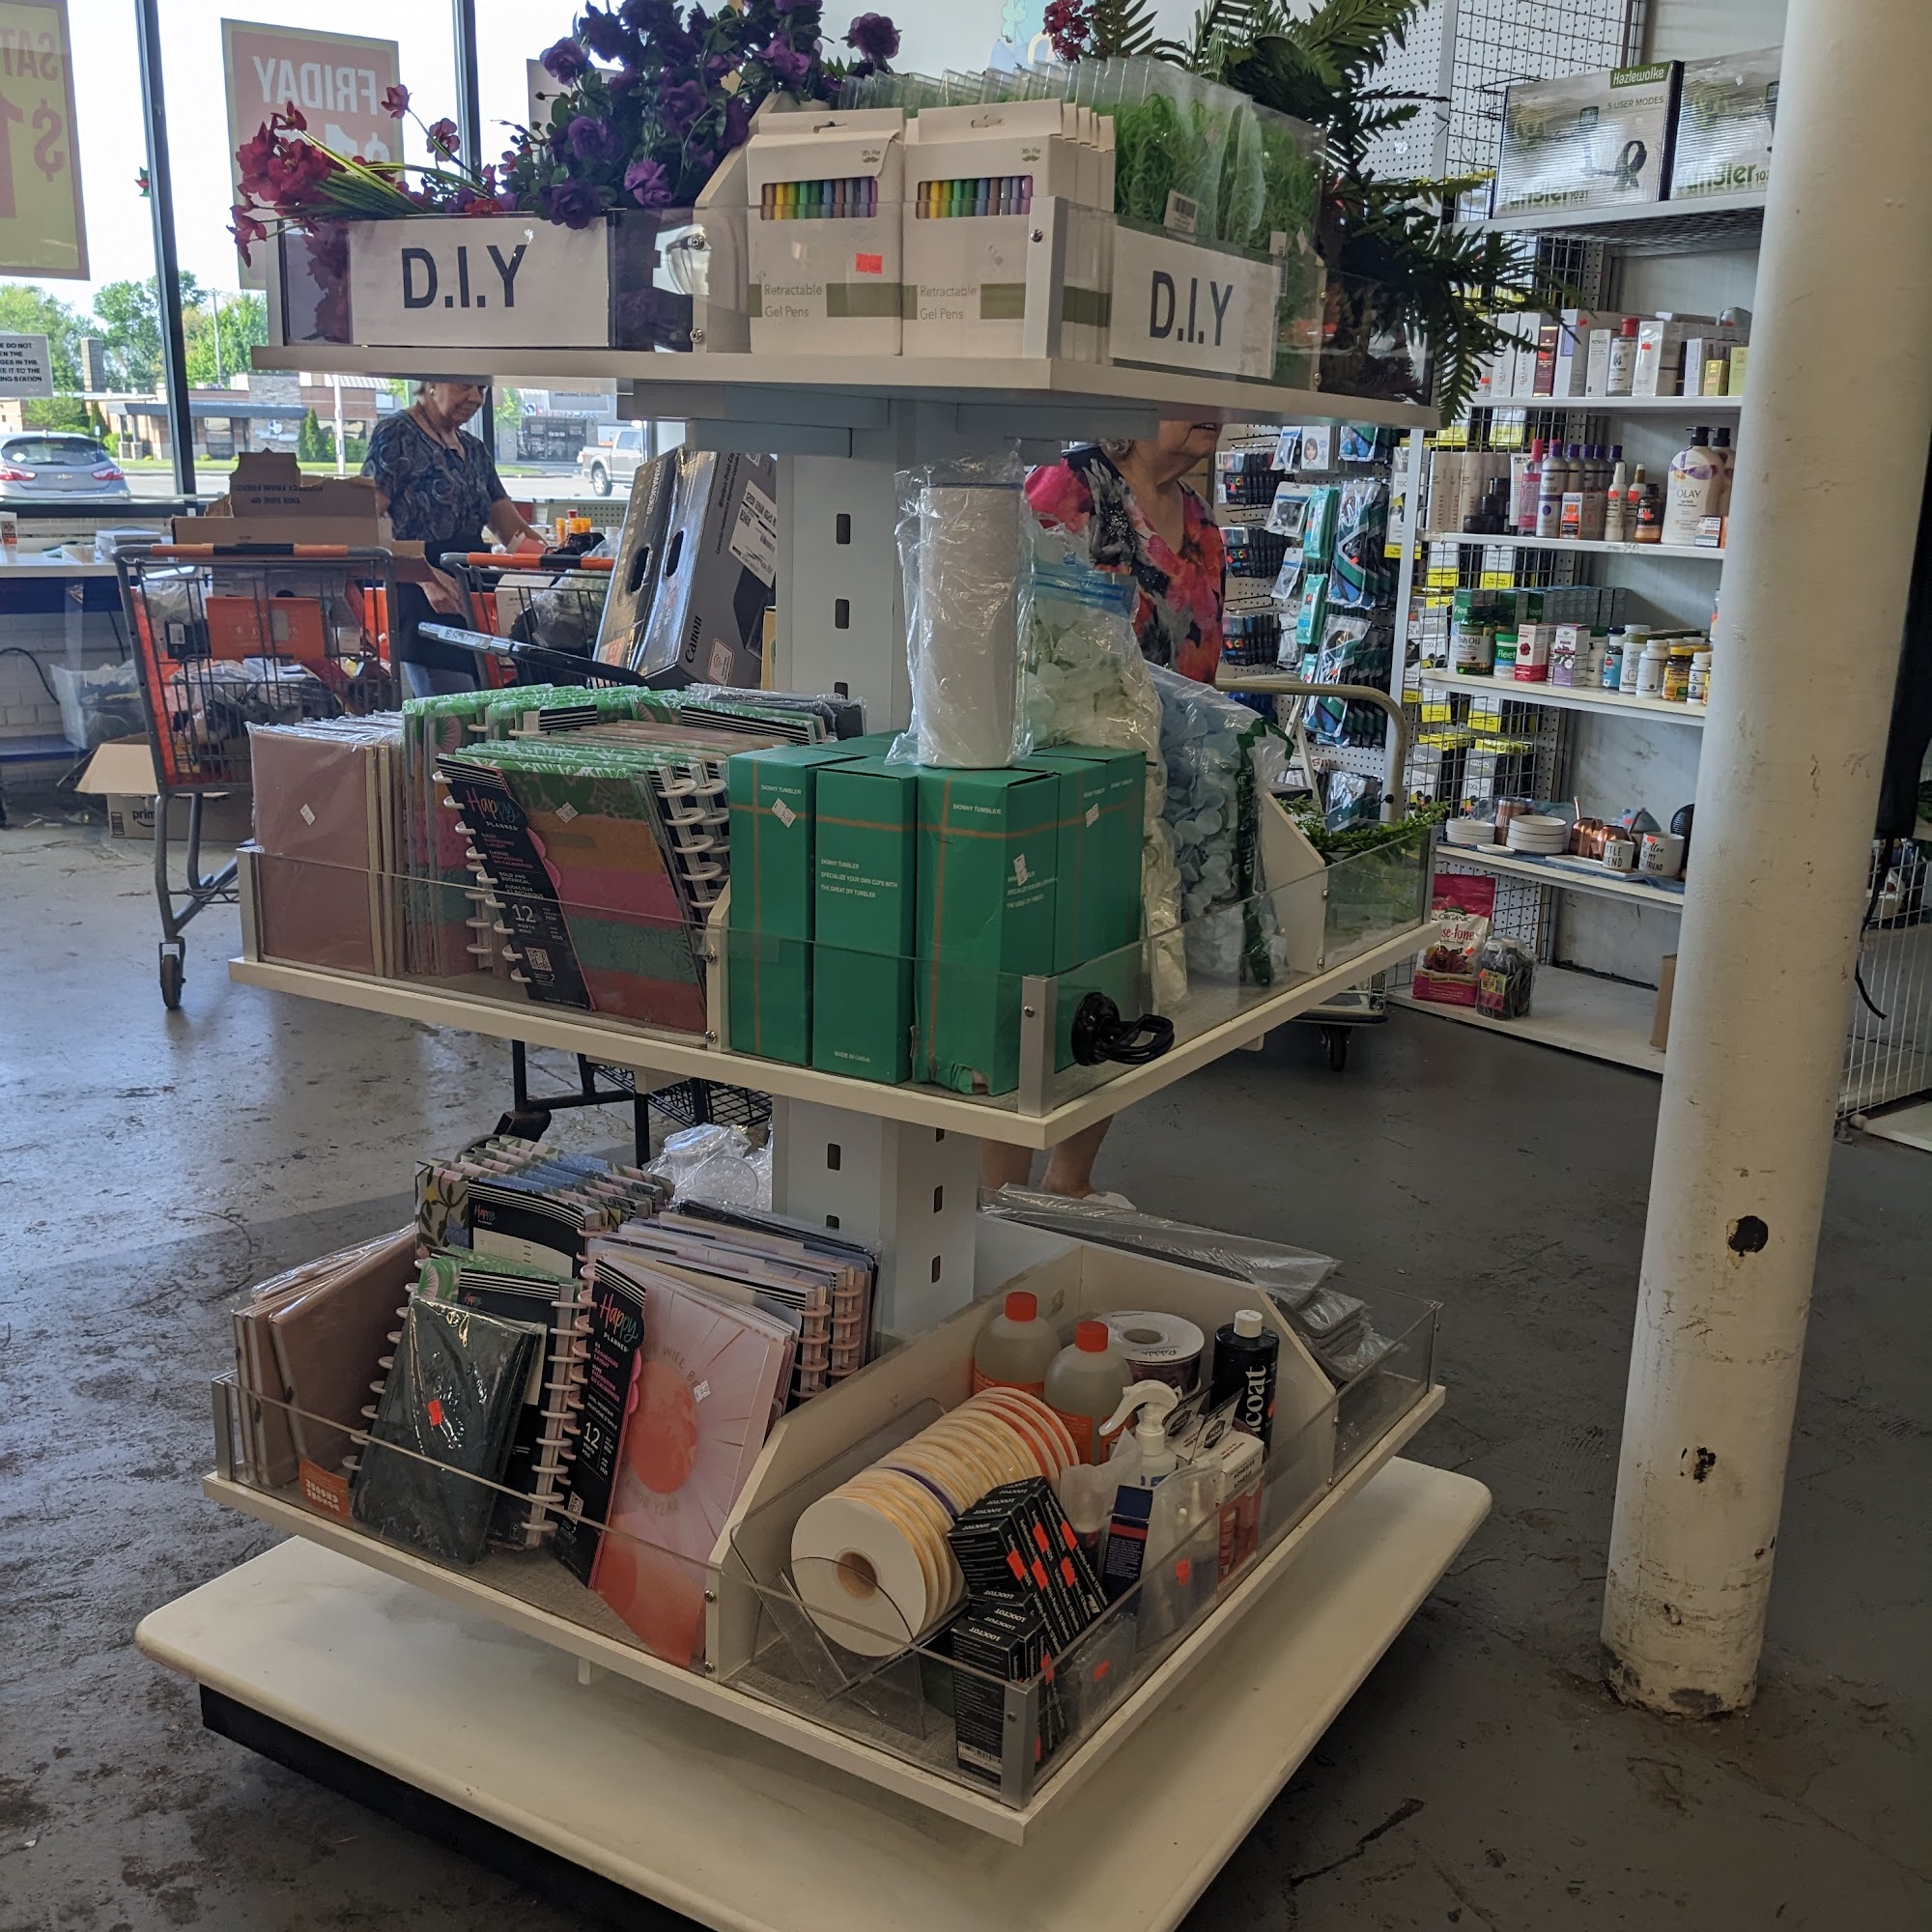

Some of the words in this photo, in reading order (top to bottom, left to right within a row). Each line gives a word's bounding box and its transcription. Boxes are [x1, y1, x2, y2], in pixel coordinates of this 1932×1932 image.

[1613, 69, 1664, 86] Hazlewolke
[1613, 99, 1633, 108] USER
[1634, 96, 1664, 107] MODES
[402, 244, 526, 309] D.I.Y
[764, 284, 822, 296] Retractable
[920, 286, 978, 298] Retractable
[765, 306, 782, 318] Gel
[785, 306, 810, 318] Pens
[920, 308, 938, 320] Gel
[940, 309, 963, 320] Pens
[1150, 270, 1234, 346] D.I.Y
[1677, 488, 1701, 498] OLAY
[1455, 606, 1467, 615] Flee
[685, 615, 702, 664] Canon
[1468, 637, 1481, 645] Oil
[1498, 649, 1517, 659] Fleet
[761, 784, 778, 793] SKINNY
[780, 786, 802, 795] TUMBLER
[466, 786, 521, 824] Happy
[952, 804, 973, 812] SKINNY
[974, 806, 1002, 814] TUMBLER
[132, 809, 156, 821] prim
[821, 859, 837, 867] SKINNY
[838, 861, 859, 869] TUMBLER
[821, 871, 845, 881] SPECIALIZE
[871, 879, 885, 888] CUPS
[854, 889, 876, 898] TUMBLER
[512, 903, 537, 924] 12
[1441, 923, 1475, 941] se-tone
[599, 1293, 639, 1344] Happy
[603, 1332, 629, 1352] PLANNER
[583, 1421, 601, 1450] 12
[983, 1590, 1014, 1600] LOOCTOT
[1095, 1585, 1110, 1606] Months
[994, 1607, 1027, 1623] LOOCTOT
[1069, 1610, 1081, 1632] Months
[983, 1616, 1015, 1631] LOOCTOT
[1059, 1620, 1071, 1641] Months
[969, 1627, 1001, 1641] LOOCTOT
